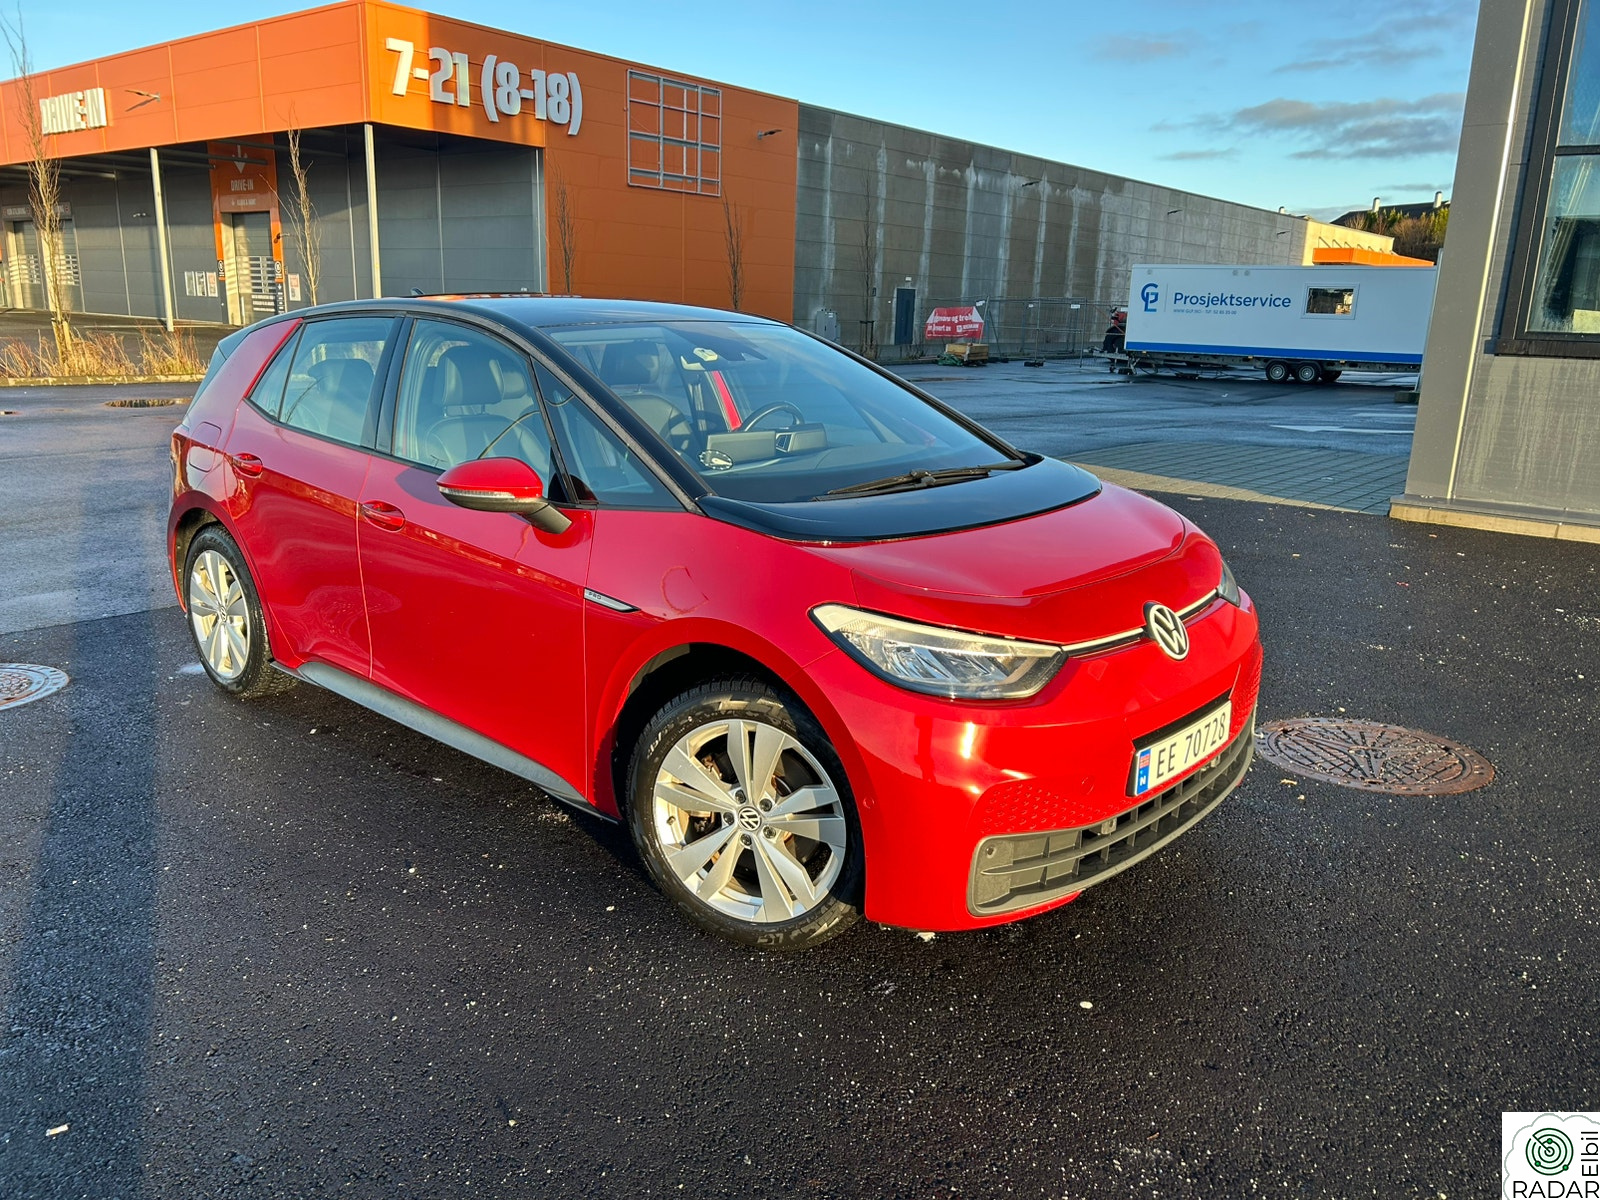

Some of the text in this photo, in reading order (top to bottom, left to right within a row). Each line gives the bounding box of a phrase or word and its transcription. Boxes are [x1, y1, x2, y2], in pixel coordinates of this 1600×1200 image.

[39, 87, 107, 135] DRIVE-IN
[385, 37, 583, 136] 7-21 (8-18)
[1173, 292, 1292, 308] Prosjektservice
[1156, 711, 1226, 779] EE 70728
